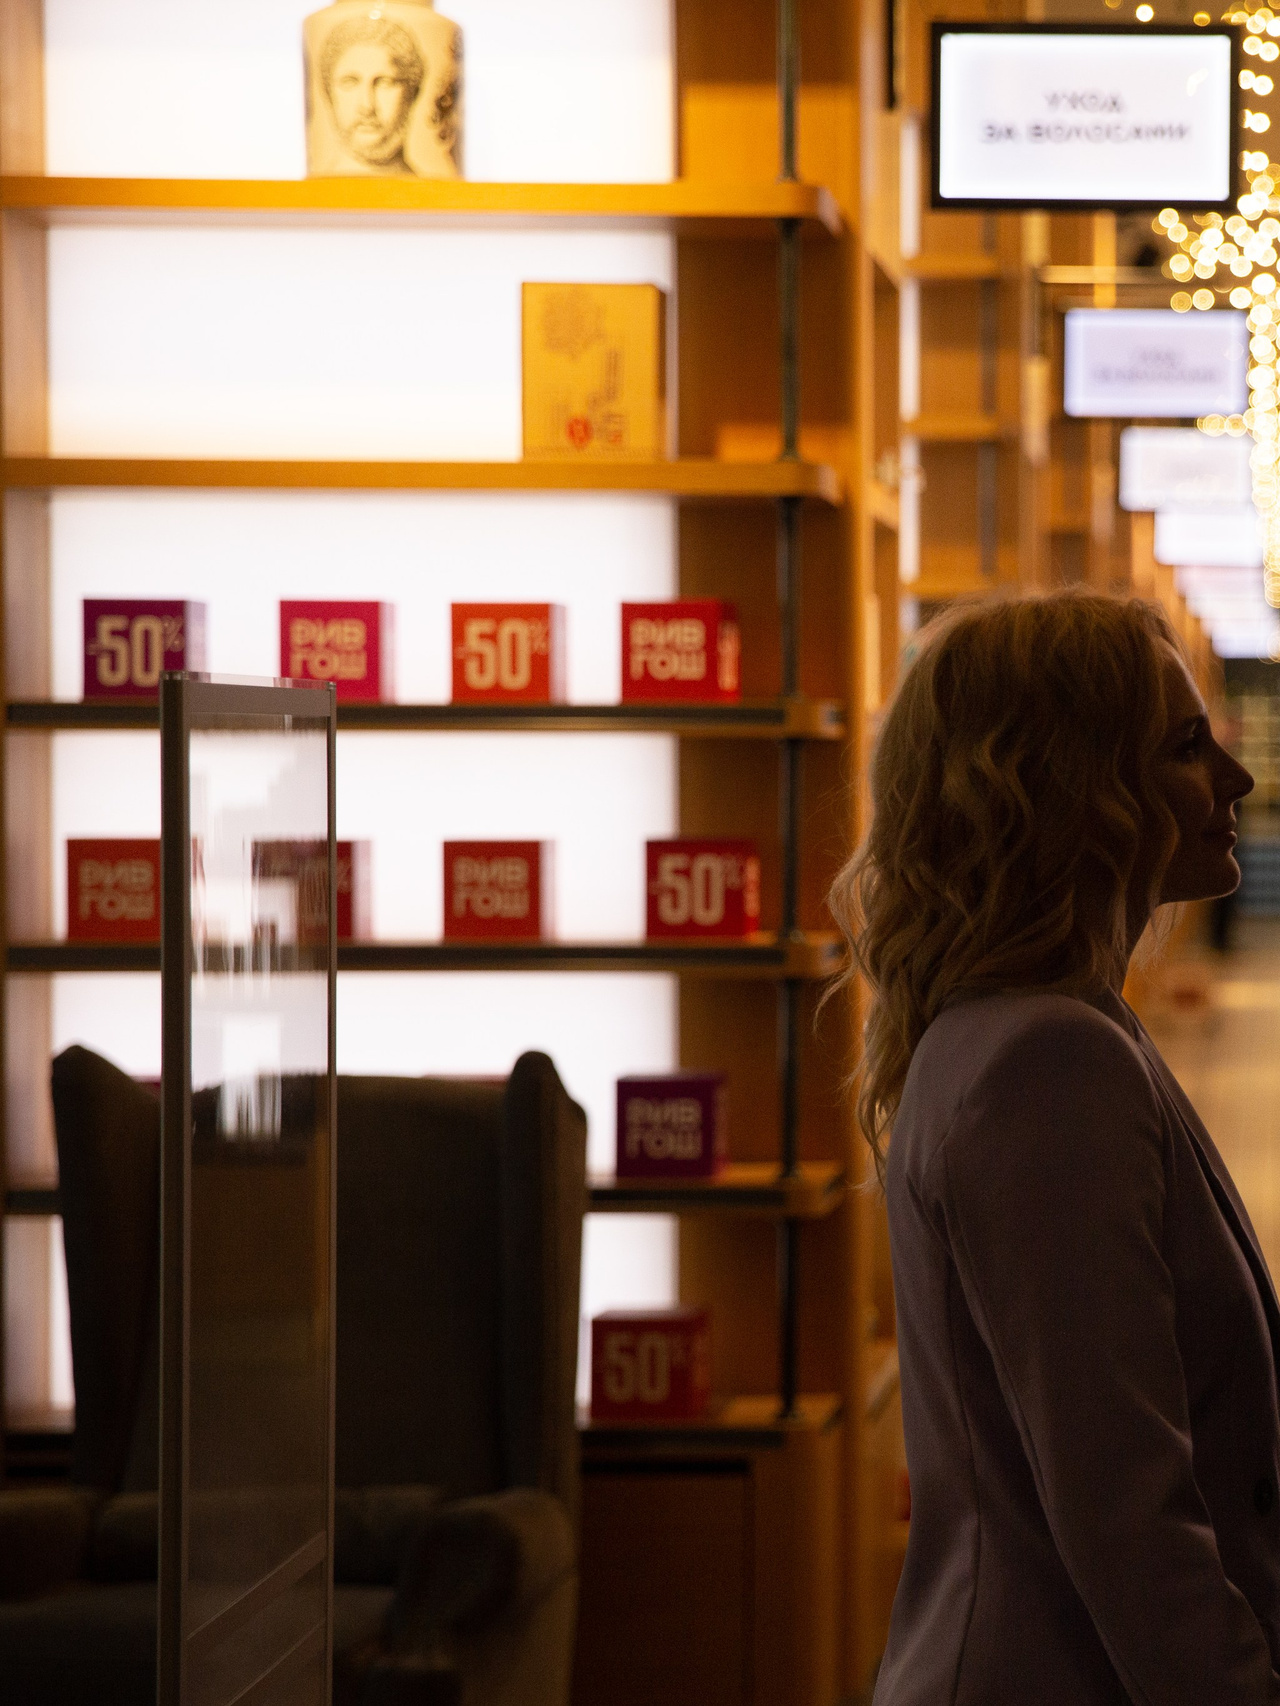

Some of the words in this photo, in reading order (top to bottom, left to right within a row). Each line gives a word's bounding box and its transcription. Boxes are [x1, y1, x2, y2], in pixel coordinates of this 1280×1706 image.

[1044, 90, 1124, 113] УХОД
[982, 120, 1018, 143] ЗА
[1028, 120, 1191, 143] ВОЛОСАМИ
